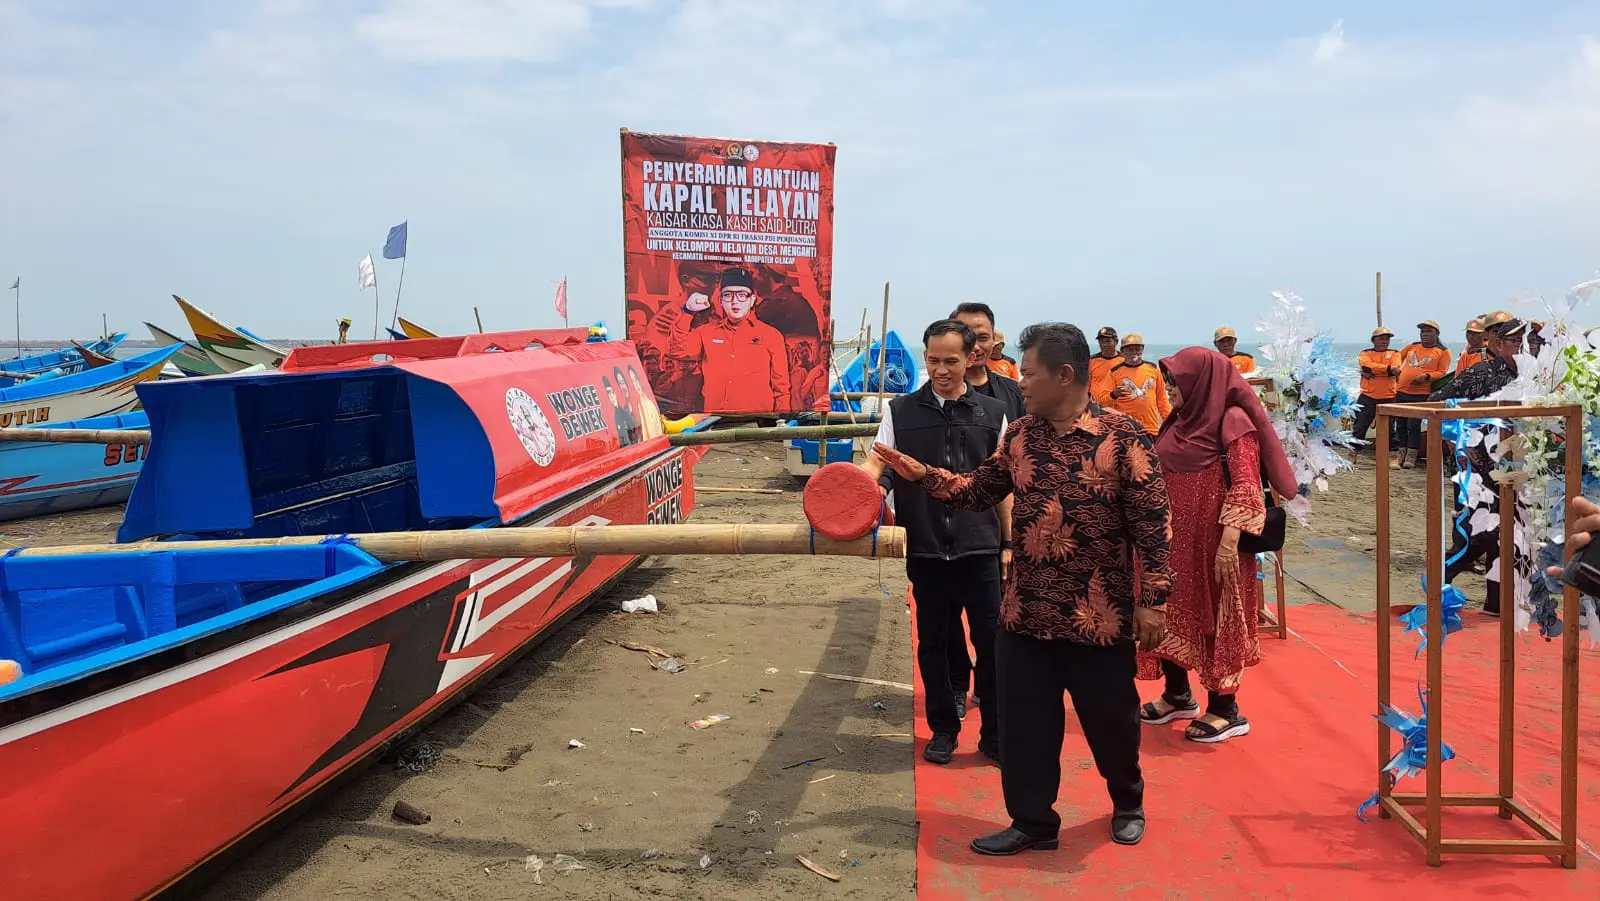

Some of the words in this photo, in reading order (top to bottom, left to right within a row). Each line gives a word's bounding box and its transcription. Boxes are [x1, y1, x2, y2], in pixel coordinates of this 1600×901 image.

[643, 160, 747, 186] PENYERAHAN
[753, 167, 819, 191] BANTUAN
[643, 183, 717, 213] KAPAL
[726, 187, 819, 219] NELAYAN
[646, 211, 688, 228] KAISAR
[691, 213, 723, 229] KIASA
[726, 215, 757, 232] KASIH
[760, 217, 783, 233] SAID
[786, 219, 817, 234] PUTRA
[649, 229, 683, 237] ANGGOTA
[684, 231, 708, 239] KOMISI
[718, 232, 731, 240] DPR
[776, 235, 816, 244] PERJUANGAN
[646, 239, 674, 251] UNTUK
[675, 240, 720, 253] KELOMPOK
[722, 242, 757, 255] NELAYAN
[759, 244, 778, 256] DESA
[780, 246, 817, 258] MENGANTI
[547, 385, 601, 416] WONGE
[558, 407, 608, 441] DEWEK
[645, 457, 683, 506] WONGE
